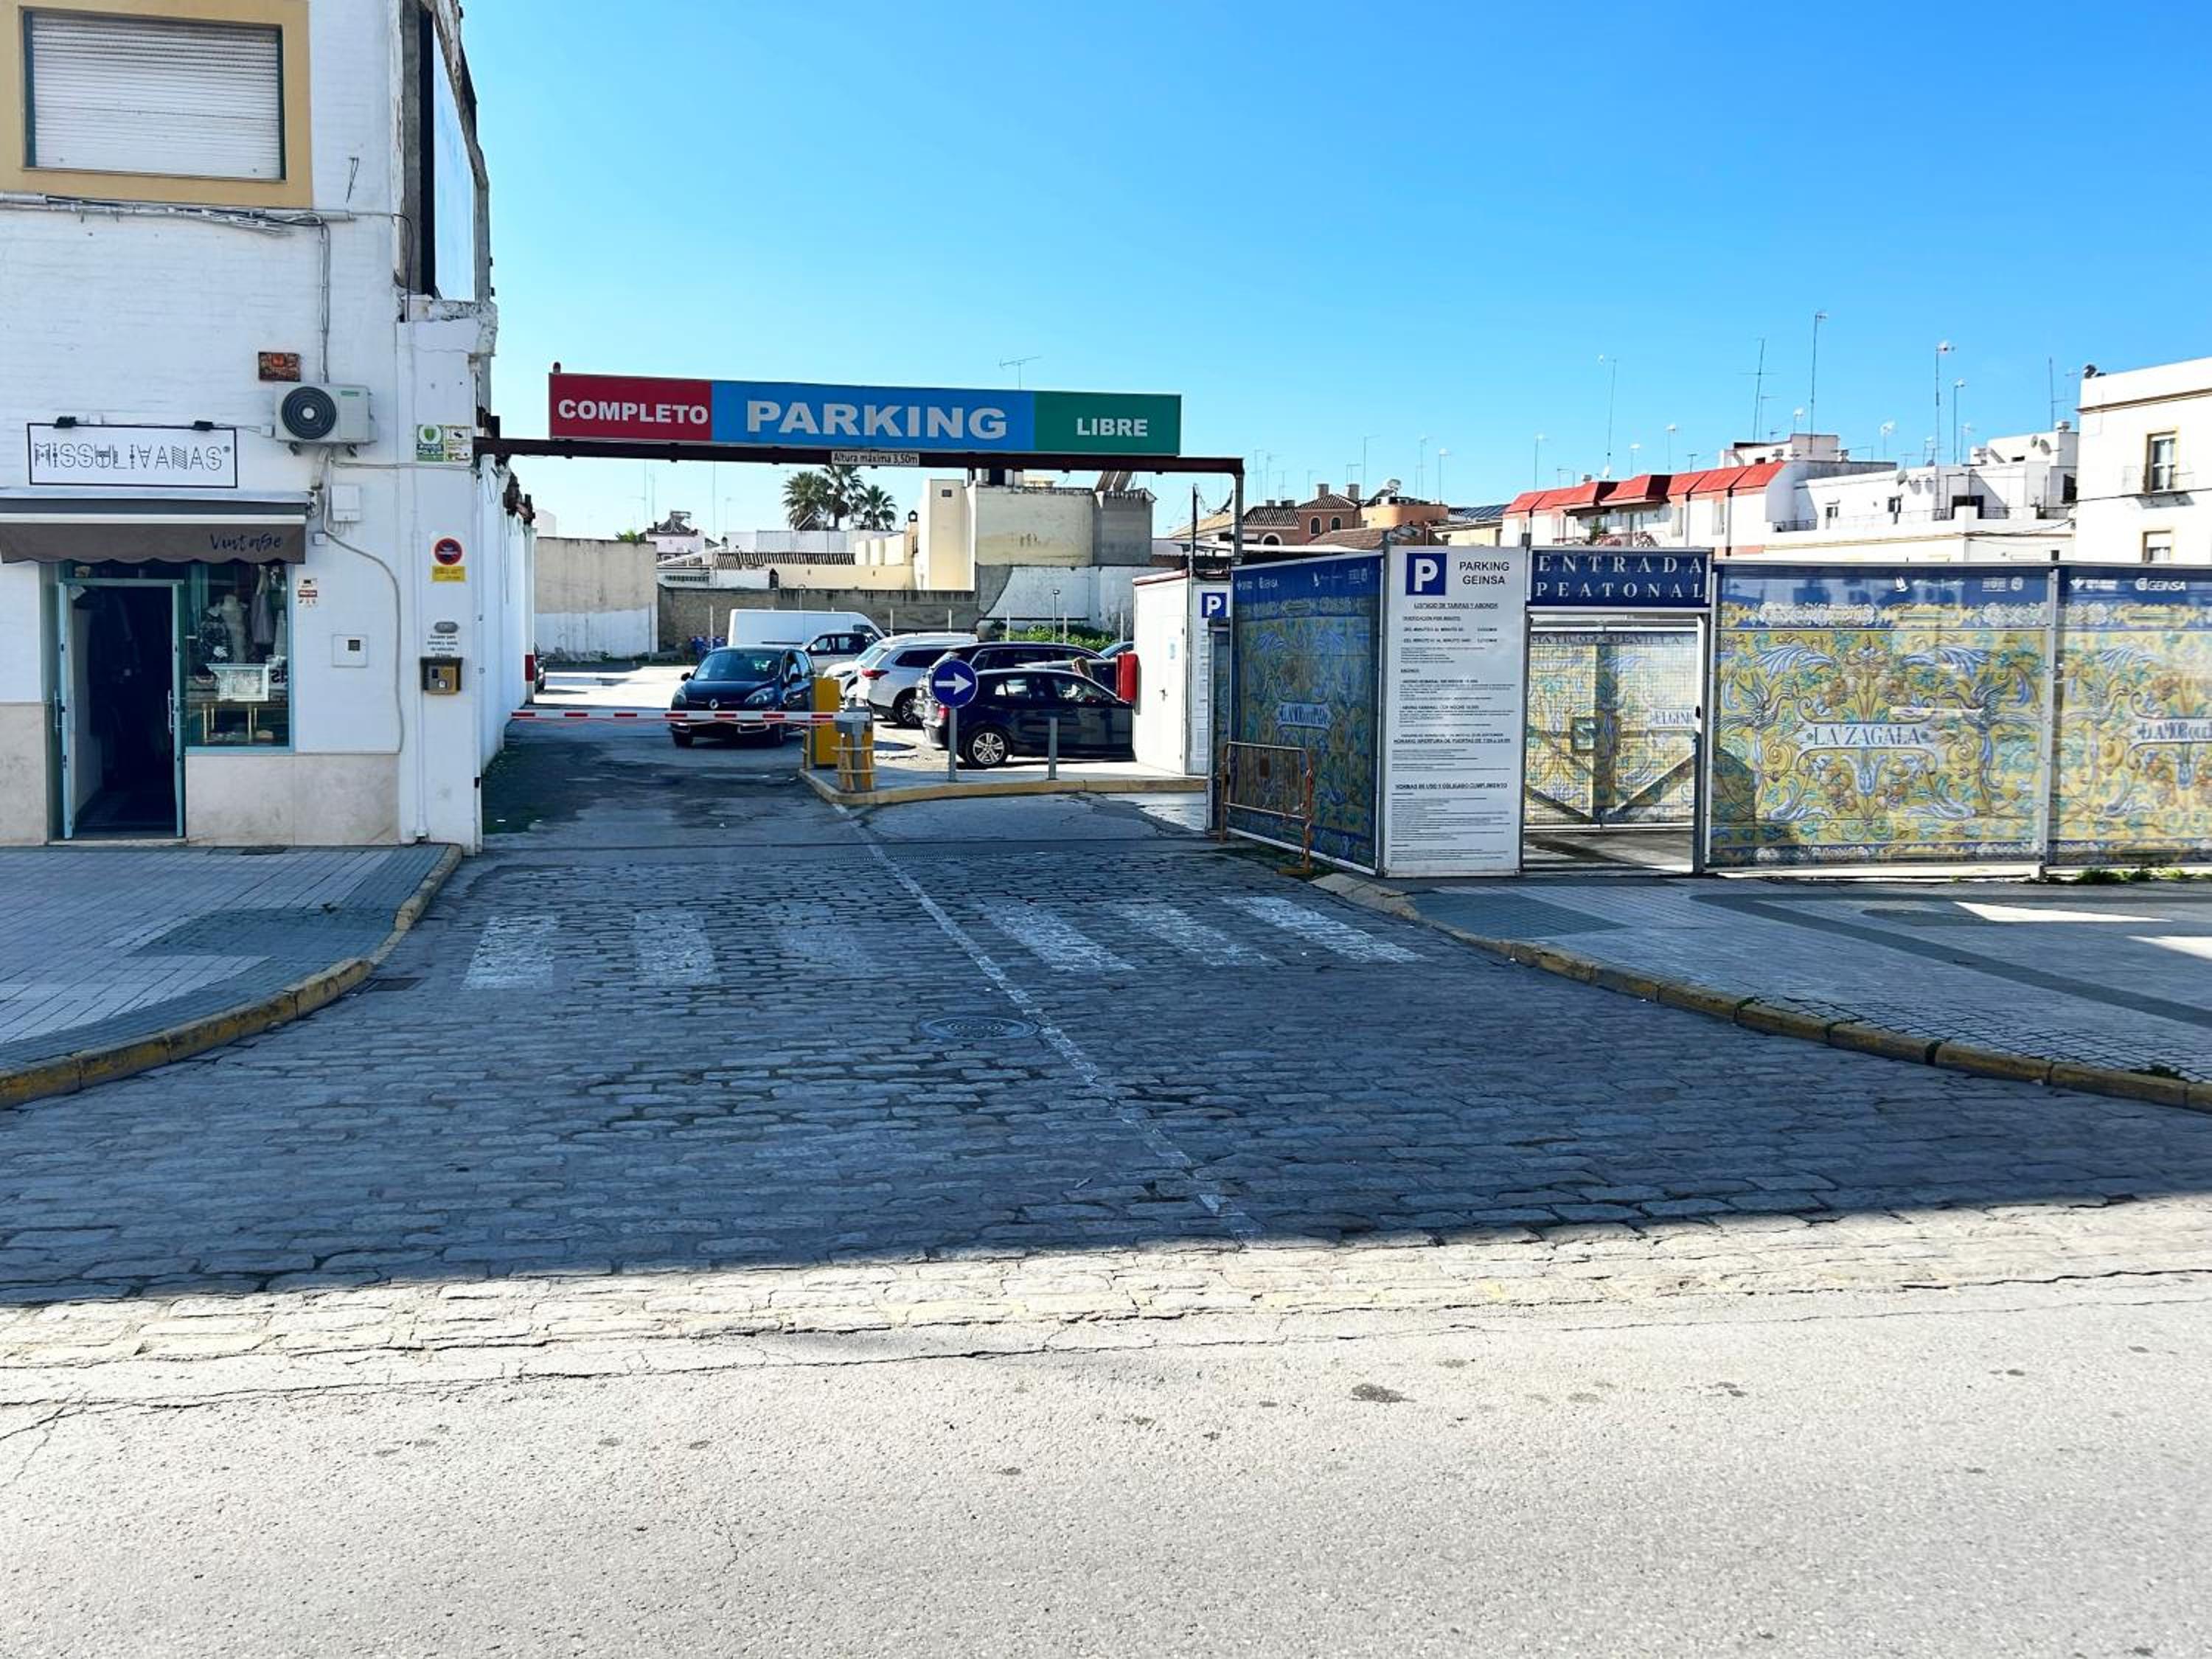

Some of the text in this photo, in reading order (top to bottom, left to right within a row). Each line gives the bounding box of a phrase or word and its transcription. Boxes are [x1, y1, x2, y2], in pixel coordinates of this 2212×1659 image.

[558, 399, 709, 425] COMPLETO
[747, 400, 1007, 439] PARKING
[1077, 417, 1148, 437] LIBRE
[834, 451, 918, 465] Altura máxima 3,50m
[1459, 561, 1510, 571] PARKING
[1538, 555, 1702, 574] ENTRADA
[1414, 558, 1439, 592] P
[1462, 575, 1506, 585] GEINSA
[1536, 582, 1705, 599] PEATONAL
[1207, 595, 1222, 616] P
[1814, 726, 1920, 745] LA ZAGALA
